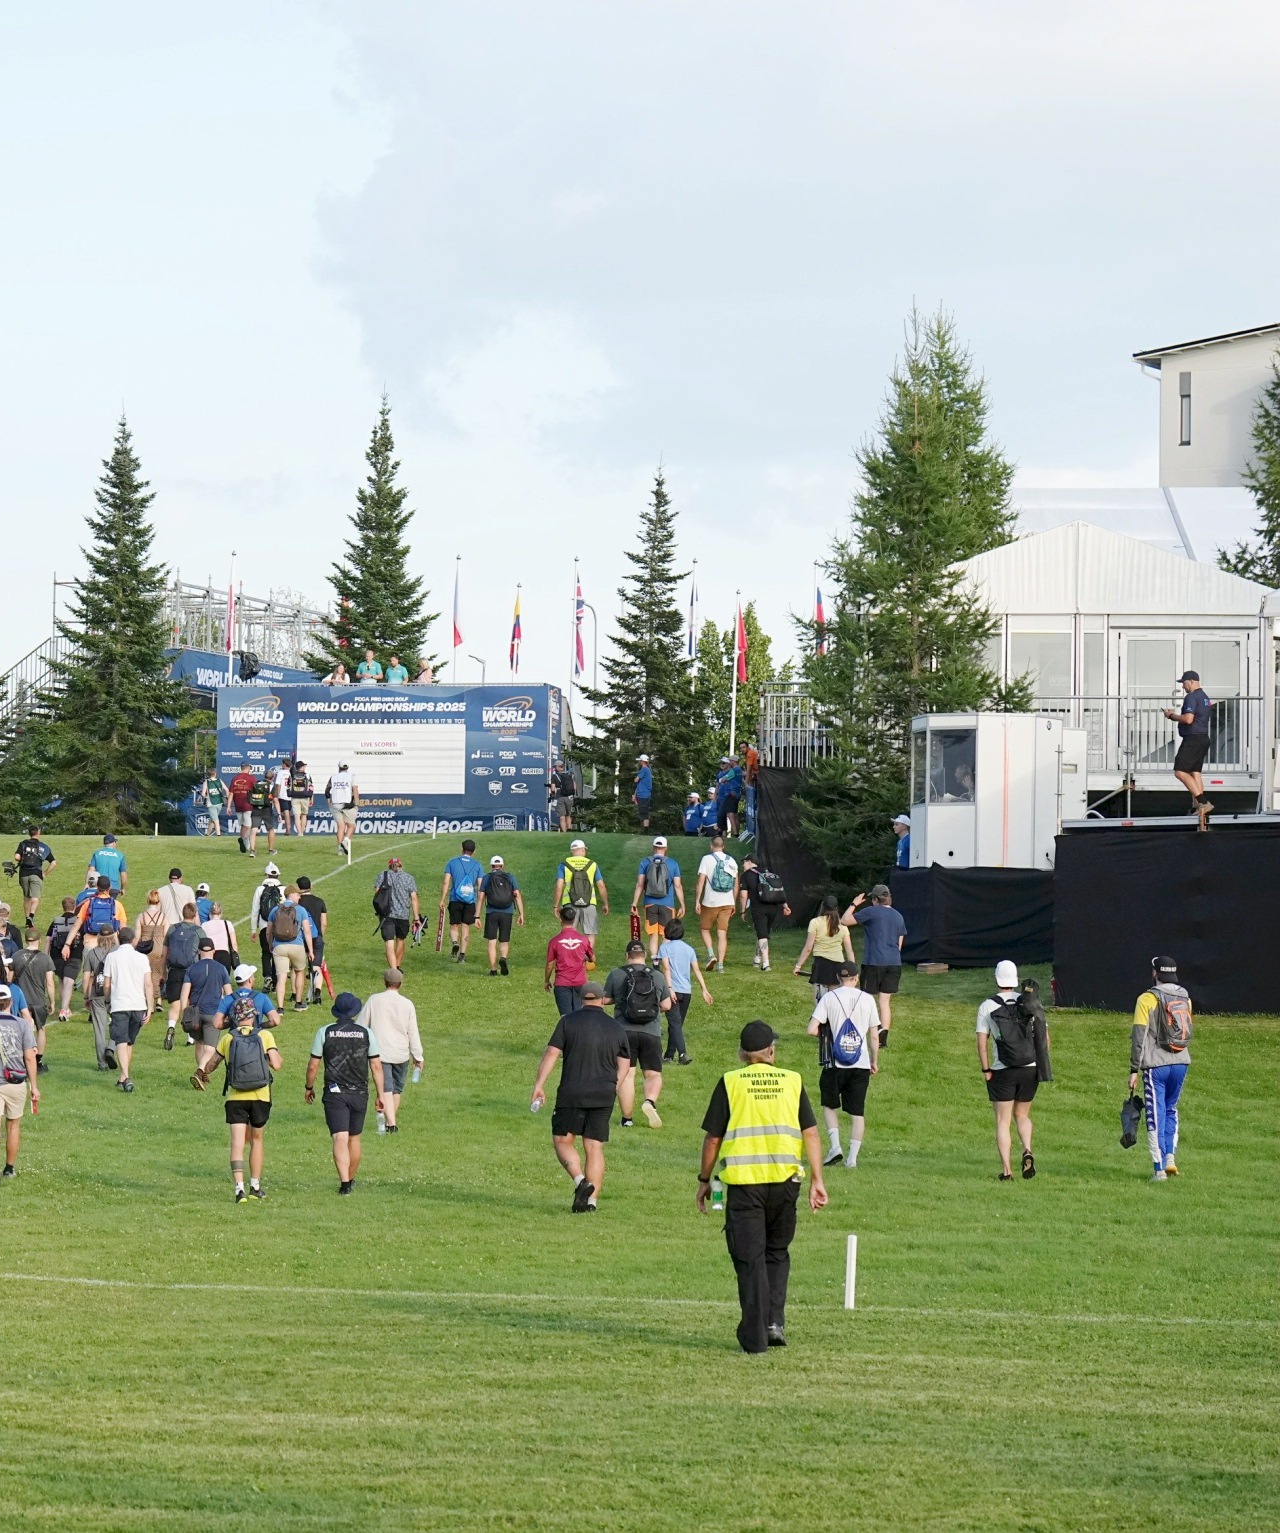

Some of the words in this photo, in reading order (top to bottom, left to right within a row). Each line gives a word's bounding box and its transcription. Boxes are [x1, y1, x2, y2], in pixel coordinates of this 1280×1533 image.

[297, 702, 340, 712] WORLD
[341, 702, 435, 712] CHAMPIONSHIPS
[435, 702, 466, 712] 2025
[229, 711, 284, 722] WORLD
[482, 710, 536, 722] WORLD
[356, 798, 412, 807] ga.com/live
[197, 815, 210, 824] dis
[495, 817, 515, 825] disc
[437, 821, 483, 834] 2025
